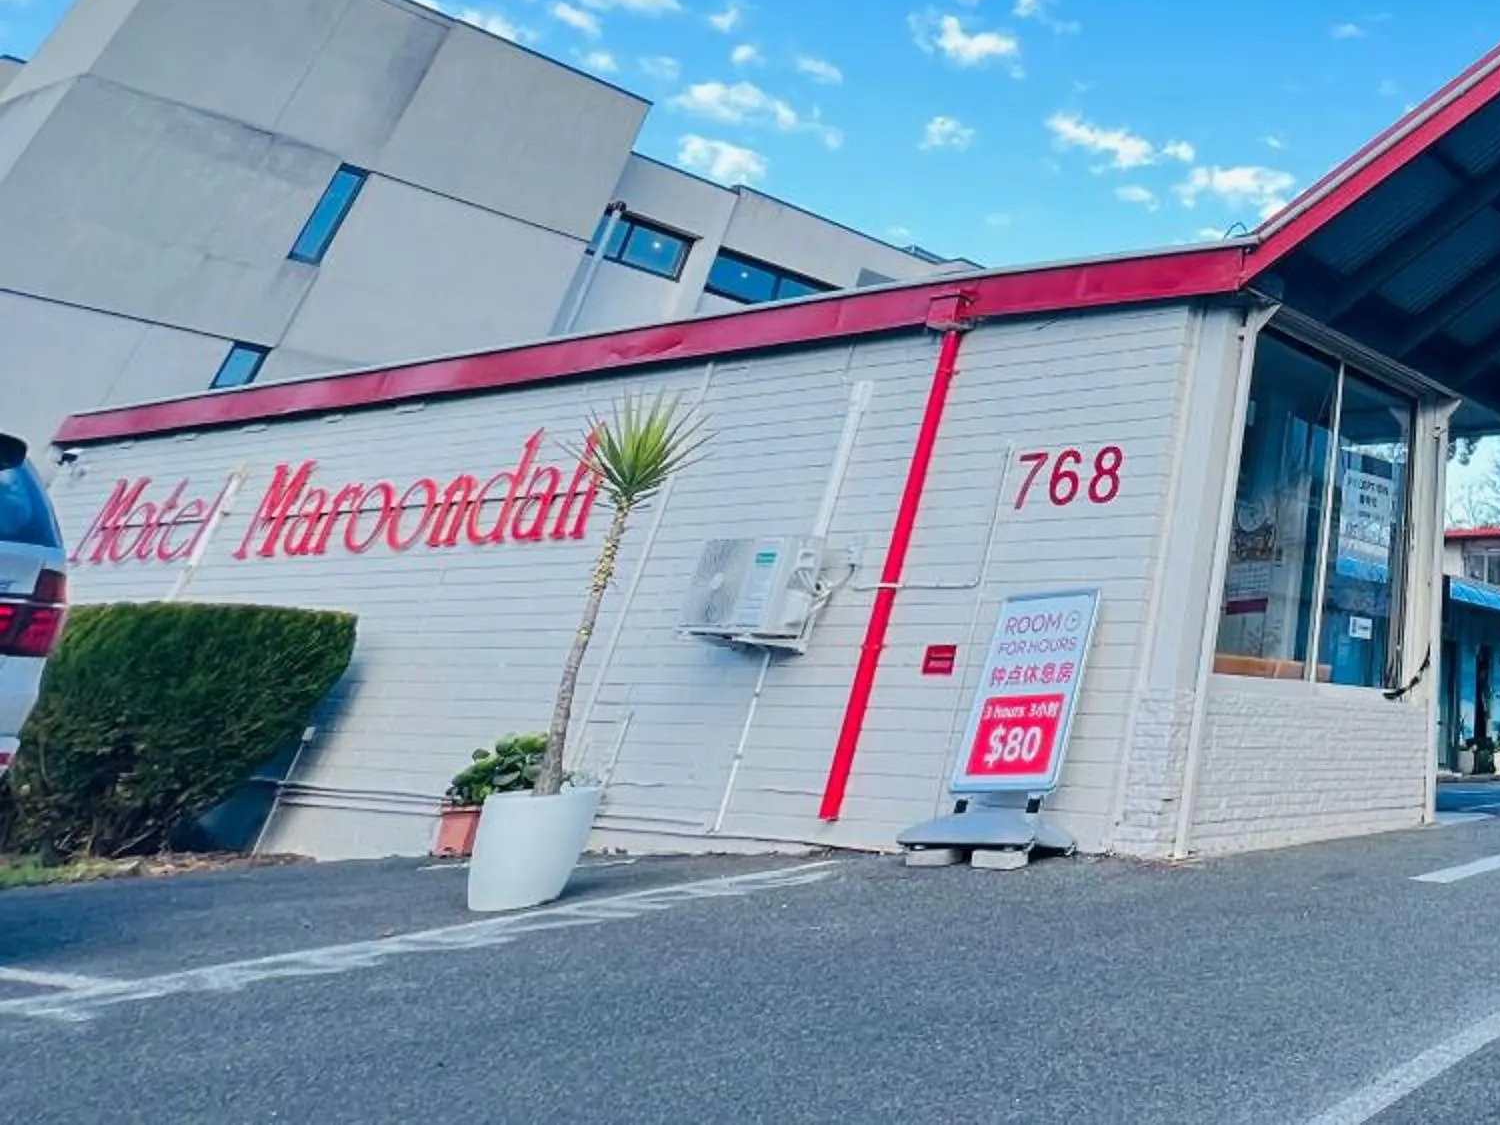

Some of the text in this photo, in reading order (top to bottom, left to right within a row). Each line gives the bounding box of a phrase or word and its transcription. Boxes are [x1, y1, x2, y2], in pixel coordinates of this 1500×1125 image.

[1013, 445, 1123, 510] 768
[67, 422, 605, 564] Motel Maroondah
[1004, 613, 1062, 636] ROOM
[998, 636, 1077, 655] FOR HOURS
[989, 661, 1074, 688] 钟点休息房
[983, 703, 993, 721] 3
[994, 703, 1025, 719] hours
[983, 723, 1042, 768] $80
